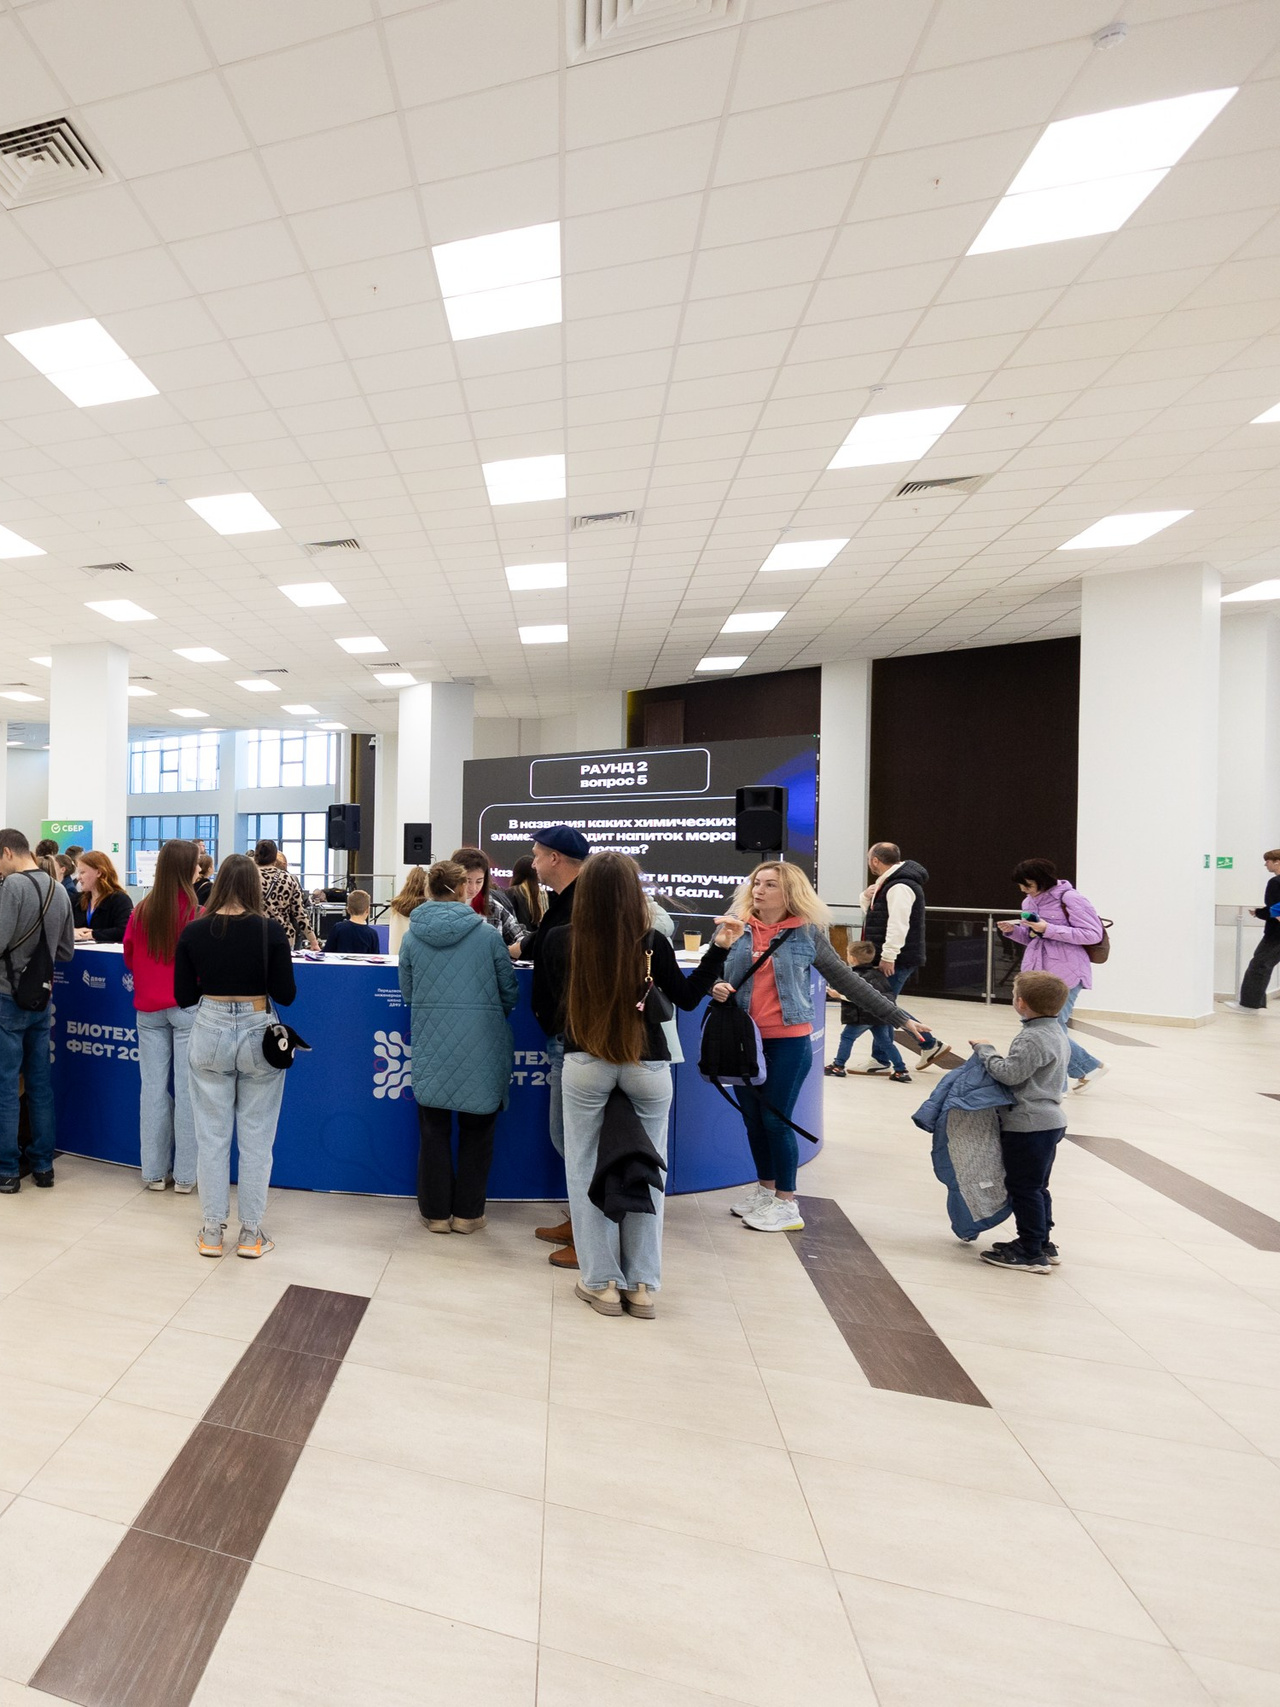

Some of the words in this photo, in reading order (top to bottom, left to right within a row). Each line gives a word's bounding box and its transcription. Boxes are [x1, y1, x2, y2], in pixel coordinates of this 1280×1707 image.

[580, 761, 635, 775] РАУНД
[636, 761, 648, 773] 2
[580, 775, 636, 789] вопрос
[637, 774, 648, 786] 5
[61, 824, 84, 832] СБЕР
[508, 819, 519, 829] В
[587, 818, 633, 829] каких
[633, 817, 737, 828] химических
[490, 832, 534, 842] элеме
[615, 831, 684, 843] напиток
[657, 873, 669, 883] и
[675, 886, 724, 899] балл.
[66, 1020, 137, 1043] БИОТЕХ
[66, 1039, 116, 1058] ФЕСТ
